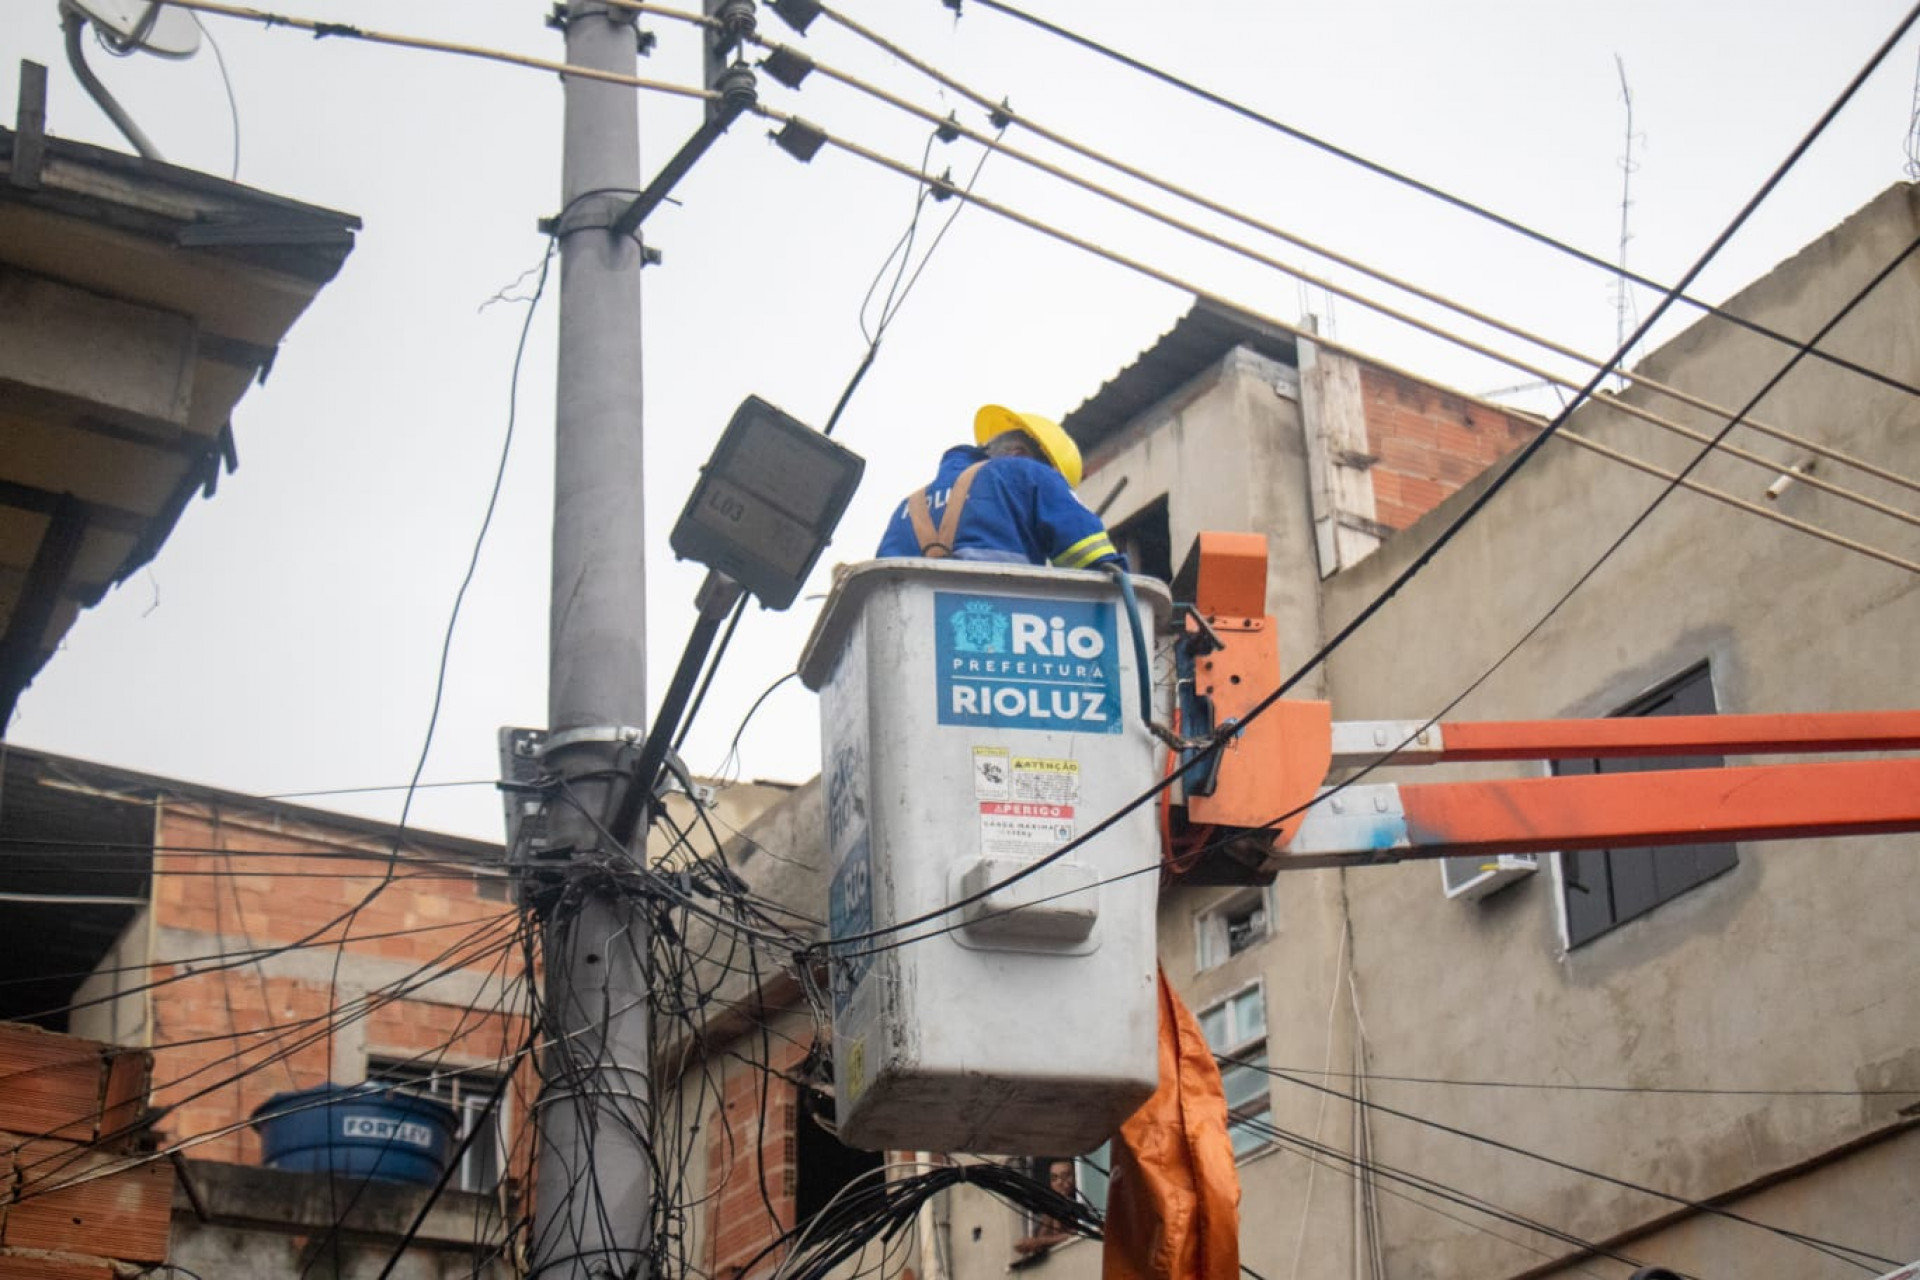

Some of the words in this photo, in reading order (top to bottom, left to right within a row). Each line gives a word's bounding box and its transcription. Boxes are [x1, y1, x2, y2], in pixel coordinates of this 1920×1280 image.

[1012, 613, 1104, 659] Rio
[953, 658, 1103, 678] PREFEITURA
[952, 685, 1107, 721] RIOLUZ
[1024, 760, 1078, 773] ATENÇÃO
[1003, 804, 1061, 818] PERIGO
[347, 1120, 428, 1143] FORTLEV
